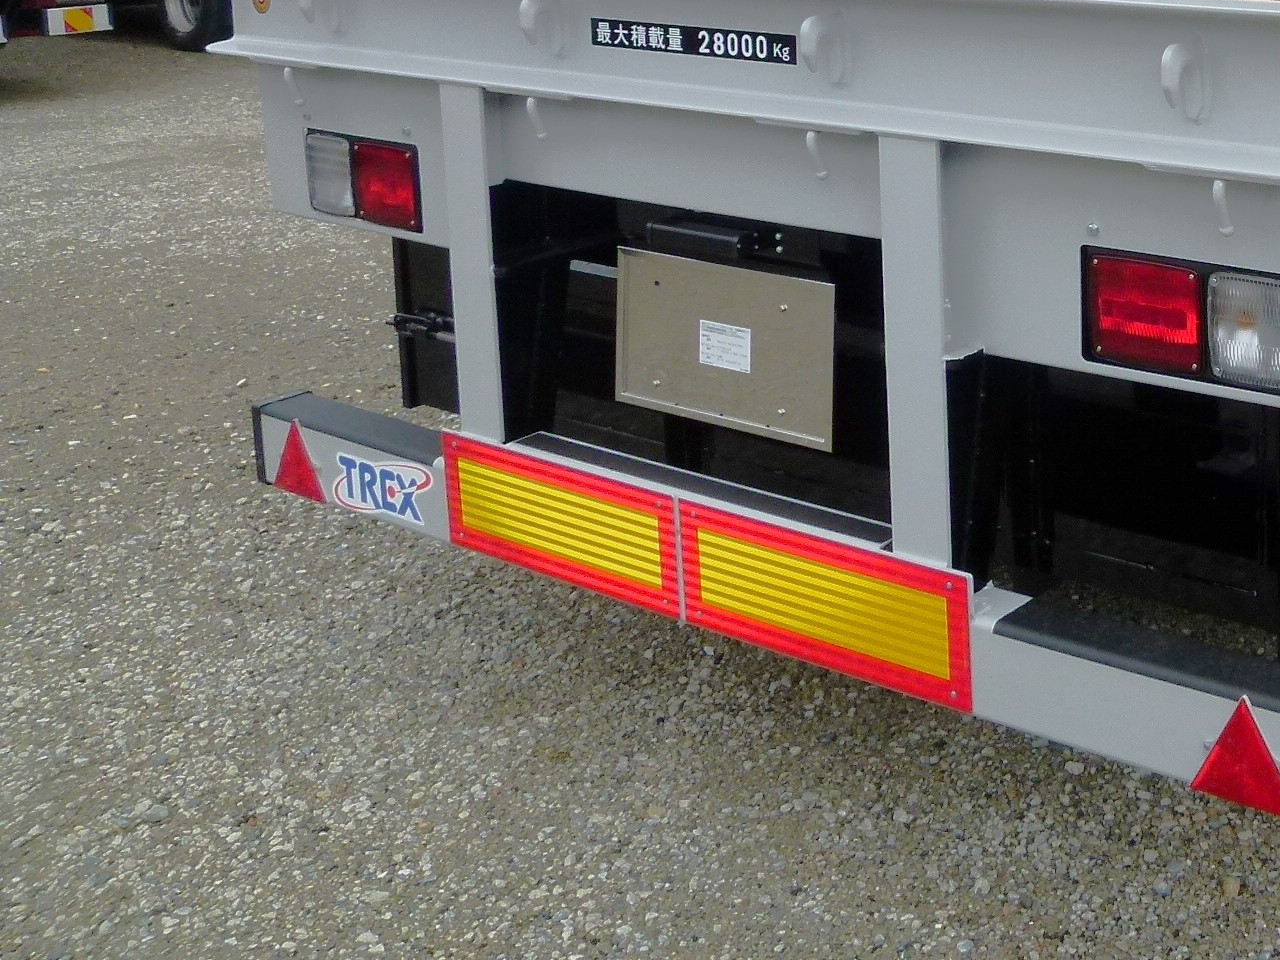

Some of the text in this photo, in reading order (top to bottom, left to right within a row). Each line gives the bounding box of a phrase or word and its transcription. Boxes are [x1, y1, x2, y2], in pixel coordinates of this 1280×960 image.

[595, 21, 684, 52] 最大積載量
[697, 30, 768, 59] 28000
[338, 455, 423, 522] TREX
